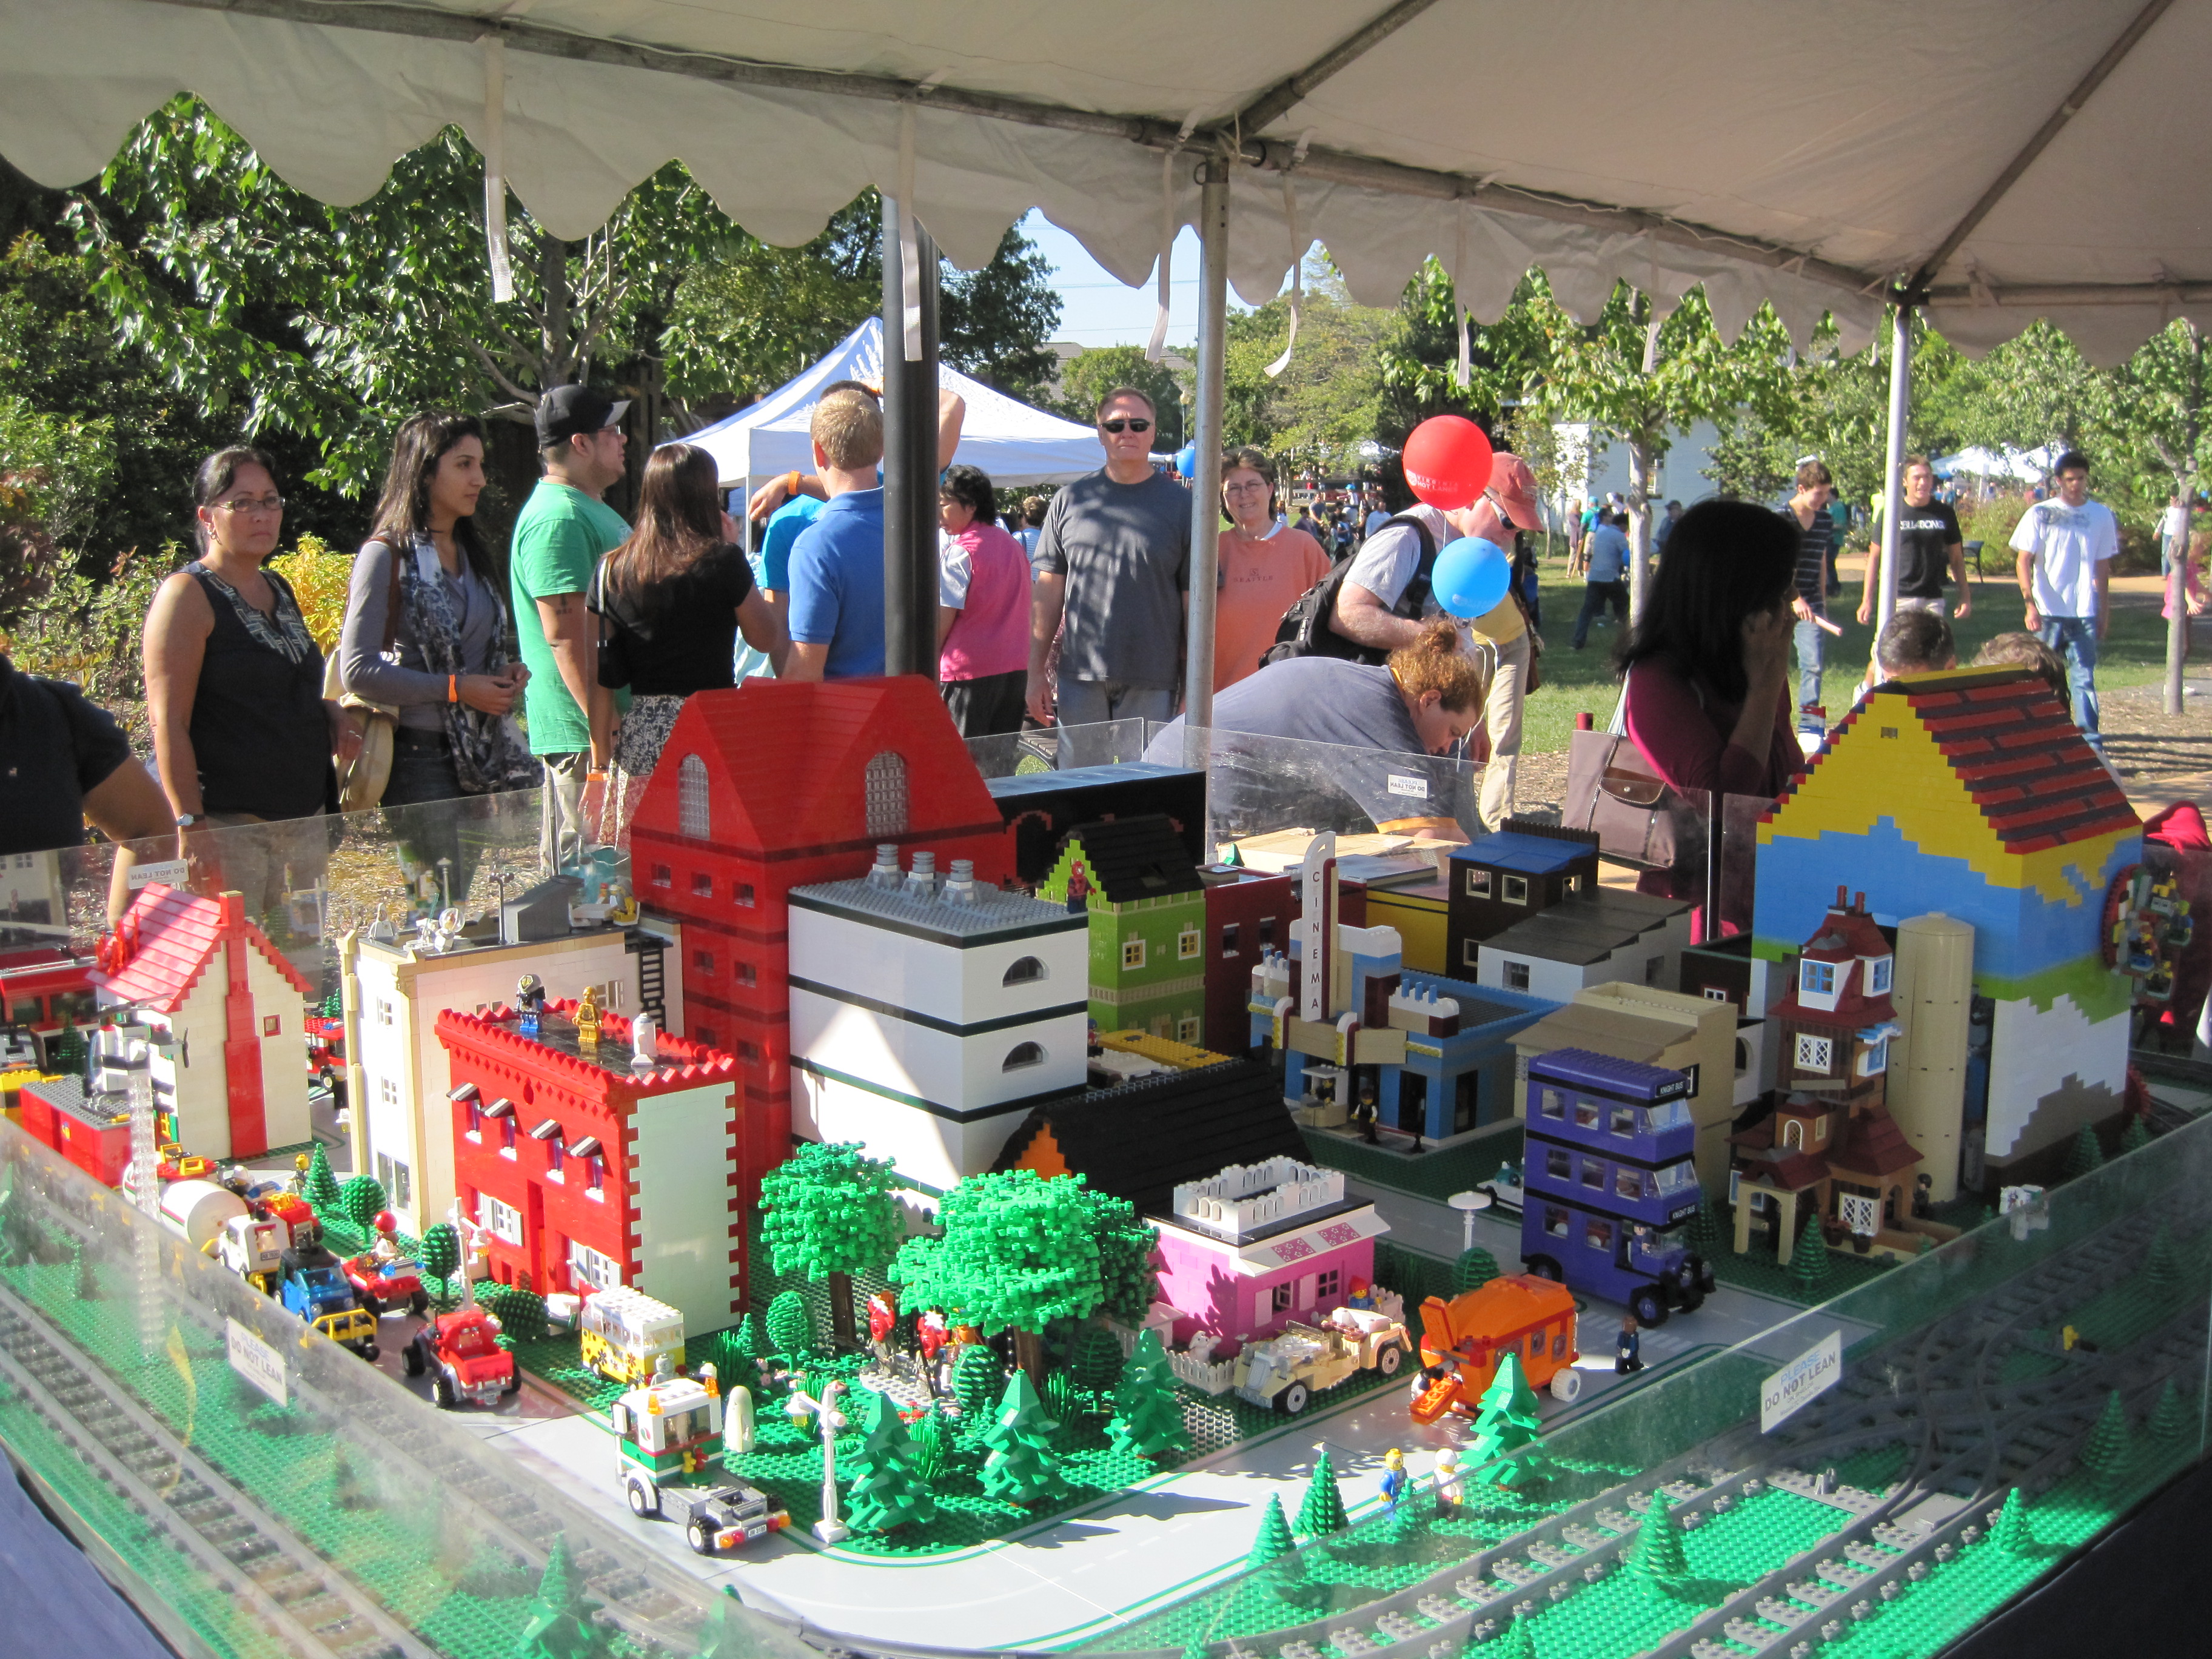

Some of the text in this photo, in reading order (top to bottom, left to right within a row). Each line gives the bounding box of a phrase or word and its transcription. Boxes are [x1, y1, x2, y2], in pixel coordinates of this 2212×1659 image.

[1416, 475, 1458, 488] VIRGINIA
[1417, 480, 1430, 490] HOT
[1311, 871, 1321, 1009] CINEMA
[1660, 1081, 1683, 1094] KNIGHT BUS
[1672, 1205, 1695, 1219] KNIGHT BUS
[230, 1336, 241, 1354] DO
[243, 1346, 260, 1367] NOT
[261, 1359, 283, 1385] LEAN
[1780, 1350, 1820, 1385] PLEASE
[1765, 1392, 1780, 1412] DO
[1783, 1373, 1806, 1399] NOT
[1809, 1351, 1836, 1381] LEAN
